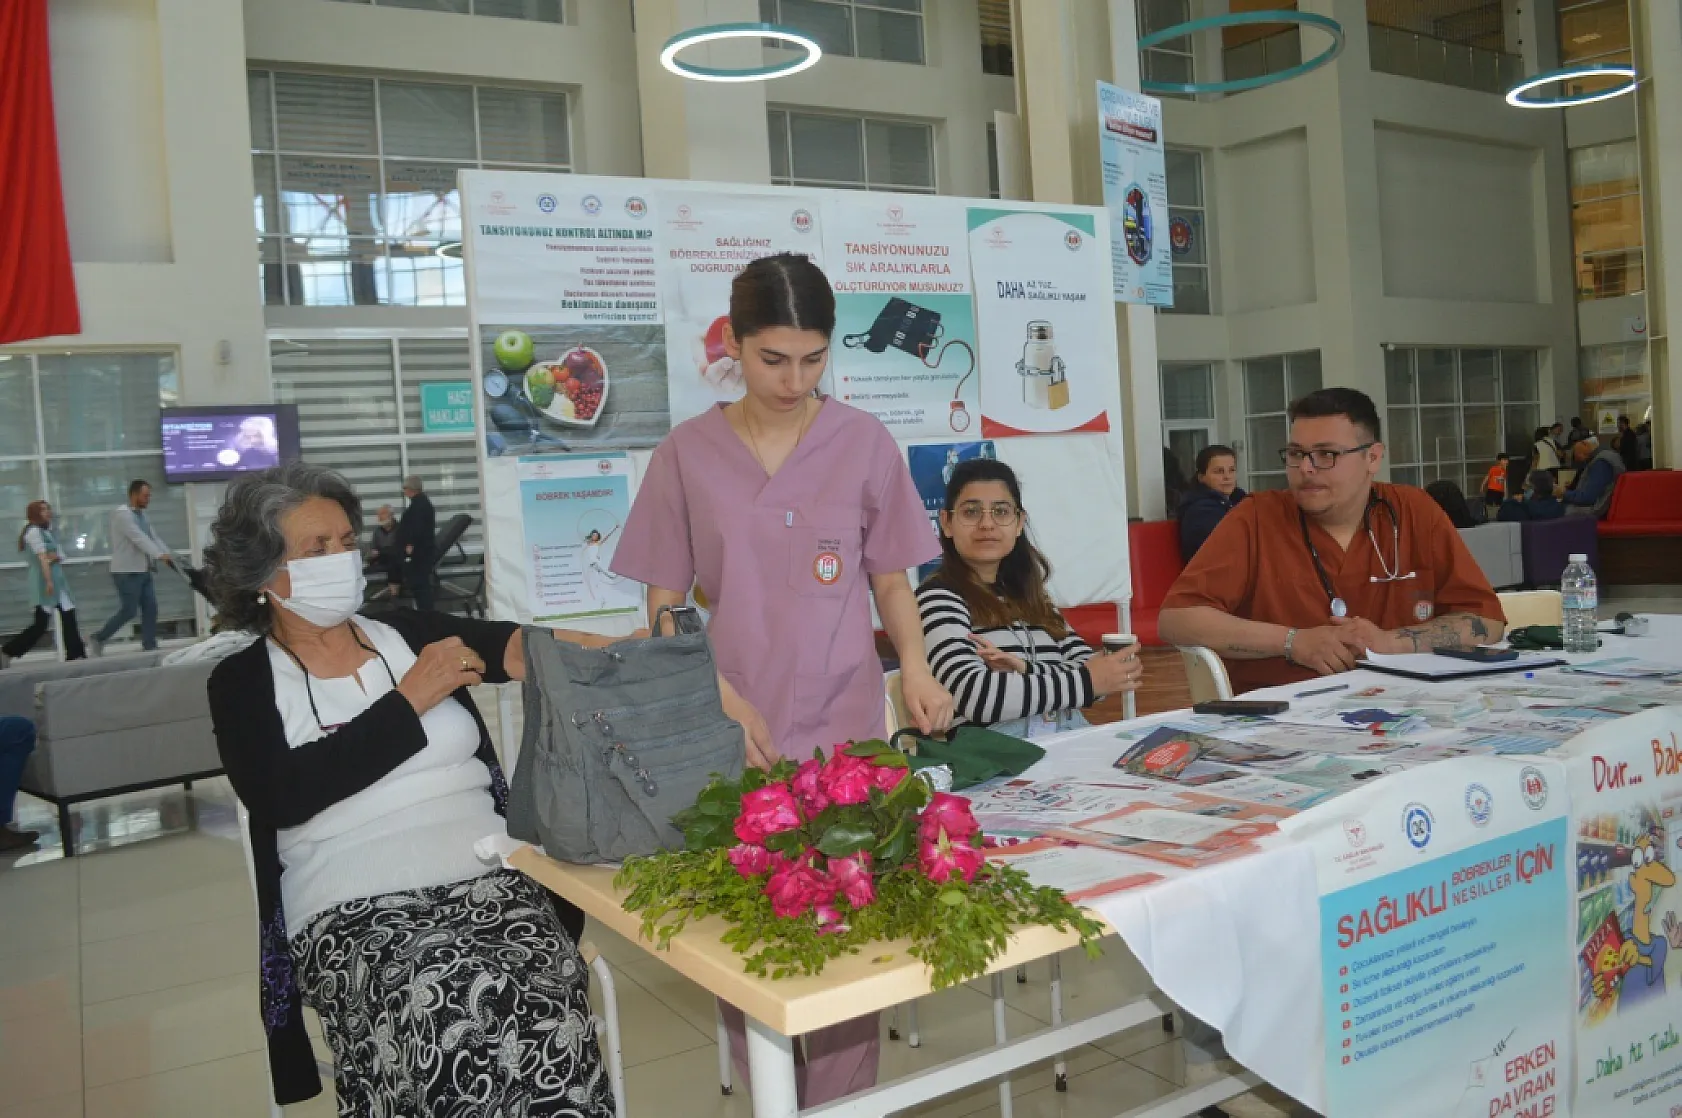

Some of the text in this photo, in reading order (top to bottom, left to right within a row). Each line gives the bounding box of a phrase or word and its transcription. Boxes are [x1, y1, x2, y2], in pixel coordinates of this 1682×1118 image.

[555, 228, 596, 239] KONTROL
[598, 230, 634, 240] ALTINDA
[716, 236, 772, 247] SAĞLIĞINIZ
[844, 241, 949, 256] TANSİYONUNUZU
[870, 263, 951, 275] ARALIKLARLA
[997, 281, 1026, 299] DAHA
[1337, 842, 1555, 949] SAĞLIKLI BÖBREKLER İÇİN
[1452, 872, 1512, 906] NESİLLER
[1505, 1039, 1556, 1083] ERKEN
[1488, 1071, 1556, 1118] DAVRAN
